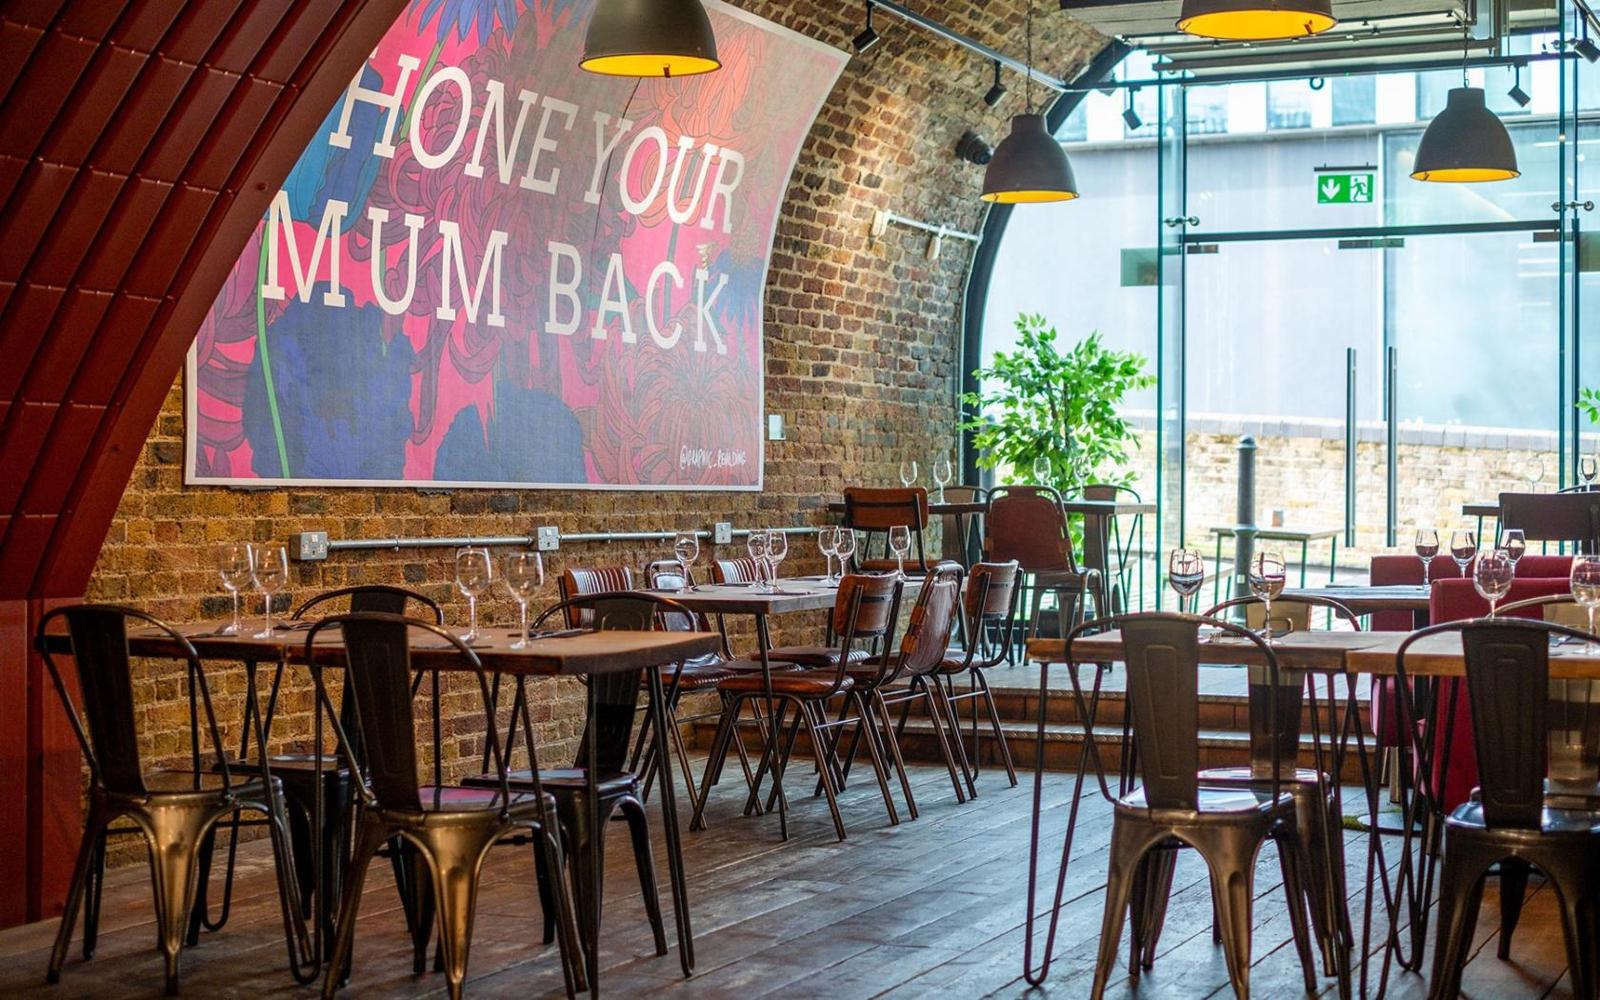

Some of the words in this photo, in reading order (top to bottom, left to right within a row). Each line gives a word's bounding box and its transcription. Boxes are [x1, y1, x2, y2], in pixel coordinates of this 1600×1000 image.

[329, 47, 579, 195] HONE
[584, 111, 745, 233] YOUR
[261, 190, 508, 327] MUM
[545, 241, 729, 355] BACK
